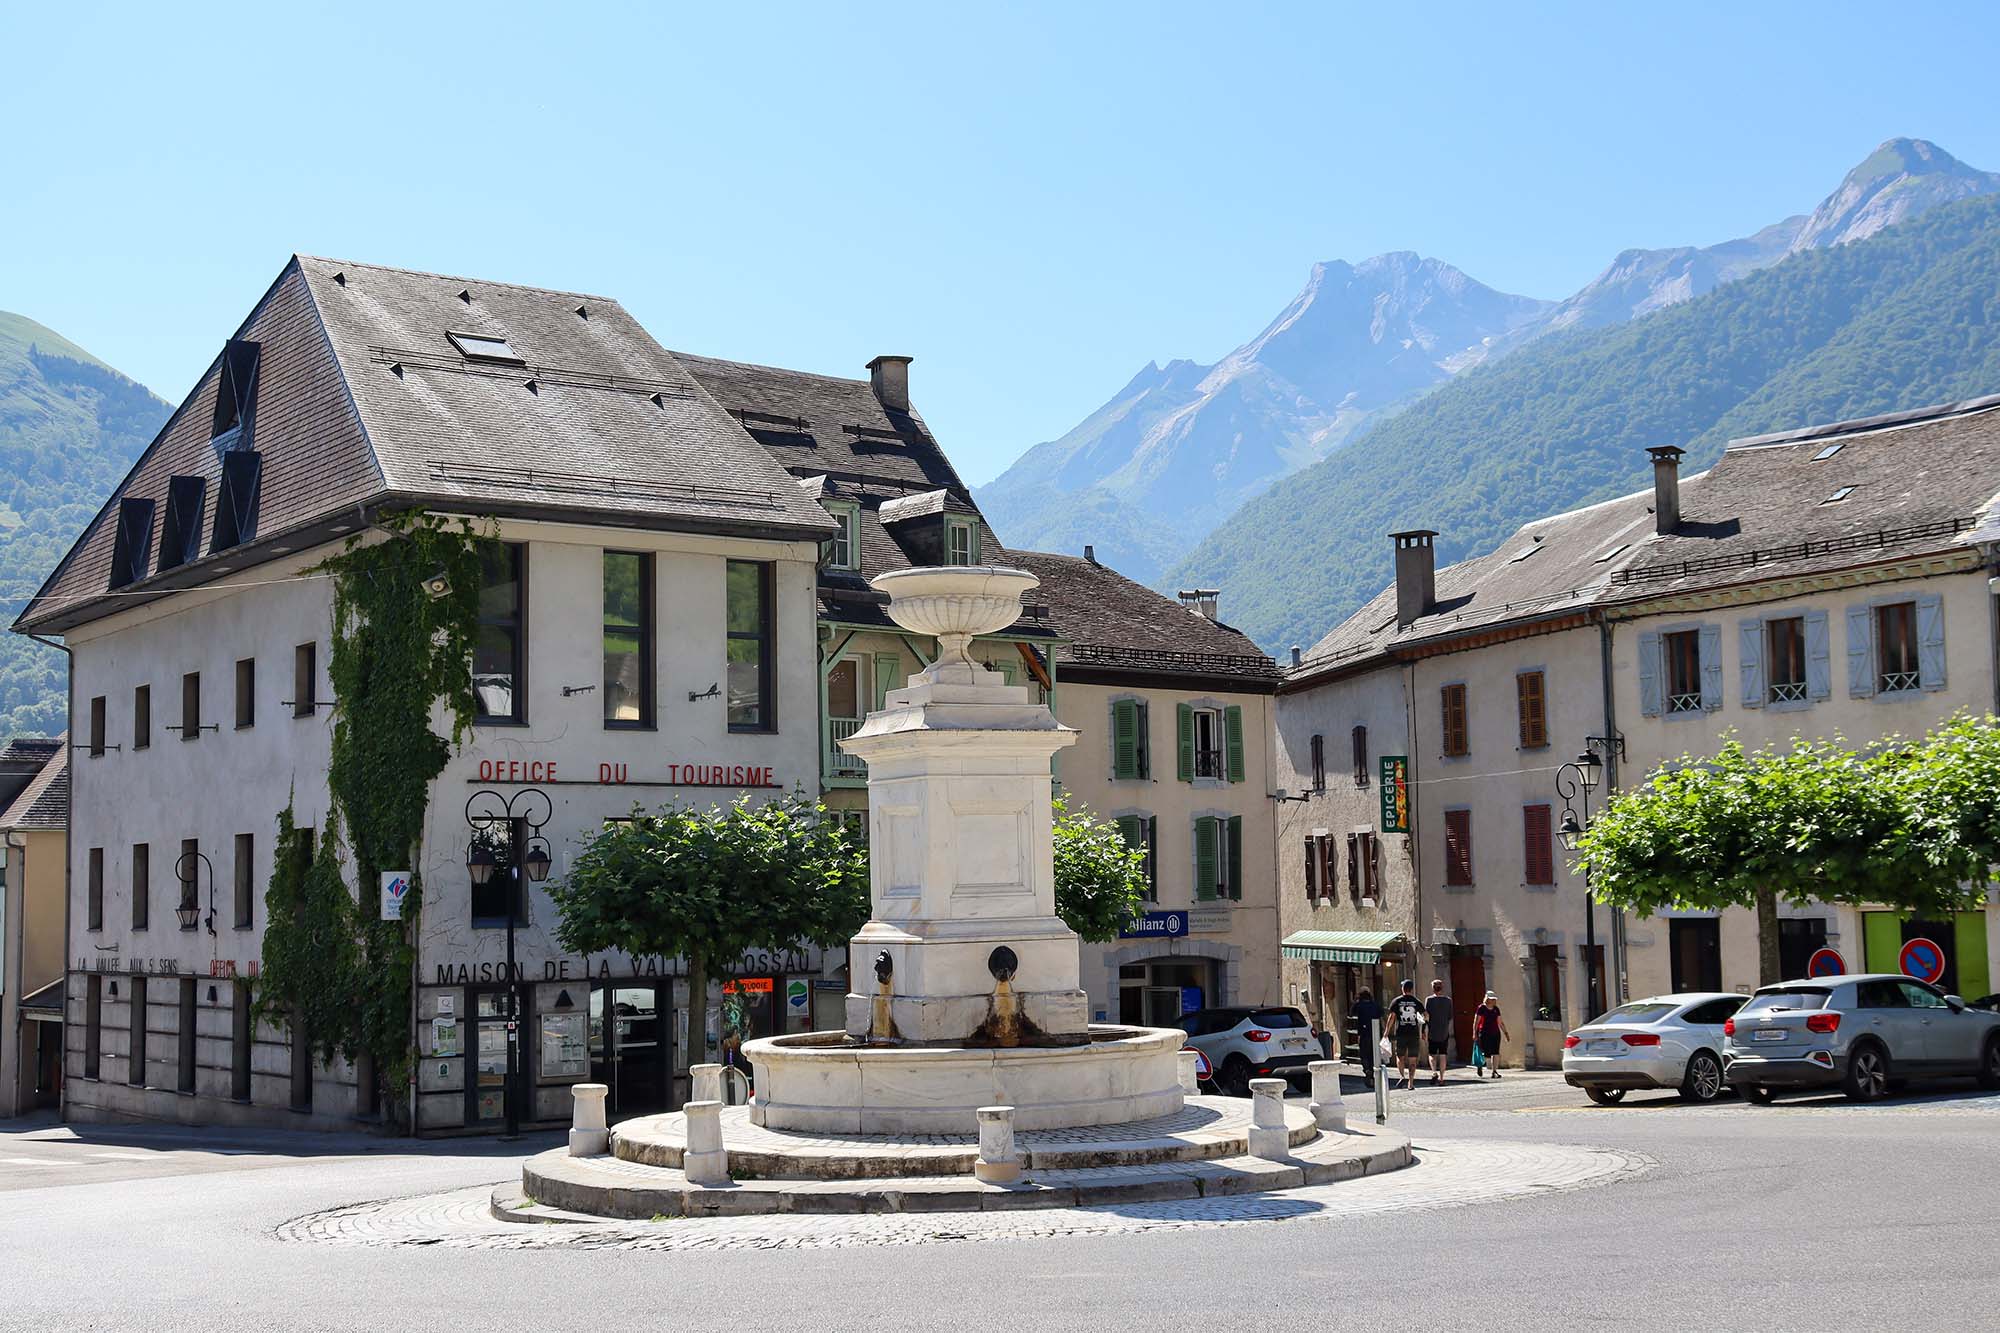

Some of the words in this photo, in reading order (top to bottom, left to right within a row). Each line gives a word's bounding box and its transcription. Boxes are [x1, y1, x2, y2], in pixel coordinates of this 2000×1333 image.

[479, 760, 557, 783] OFFICE
[599, 763, 628, 784] DU
[668, 764, 774, 787] TOURISME
[1384, 761, 1396, 829] EPICERIE
[1128, 918, 1165, 931] Allianz
[159, 958, 178, 975] SENS
[437, 961, 525, 985] MAISON
[544, 960, 570, 982] DE
[586, 958, 612, 979] LA
